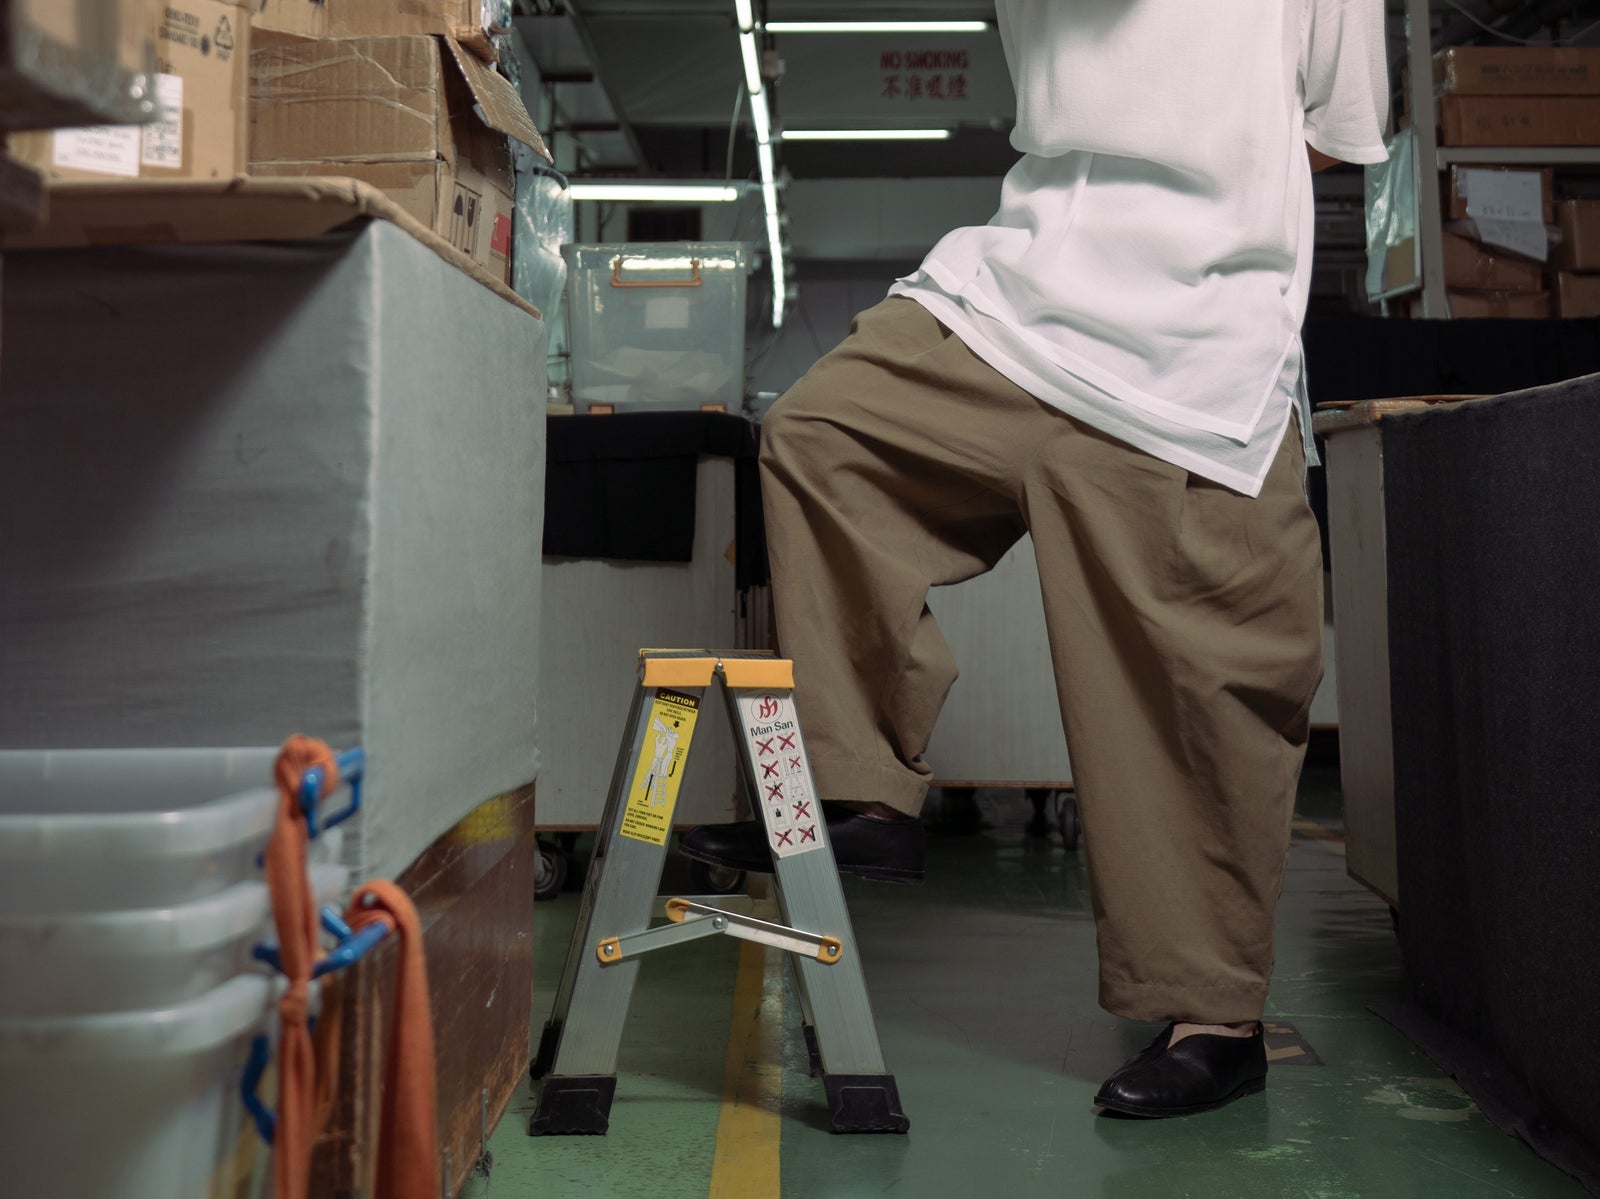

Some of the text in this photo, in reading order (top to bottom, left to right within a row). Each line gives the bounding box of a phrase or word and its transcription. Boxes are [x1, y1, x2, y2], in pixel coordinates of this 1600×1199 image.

[880, 49, 969, 70] NO SMOKING
[660, 692, 696, 707] CAUTION
[750, 720, 794, 737] Man San
